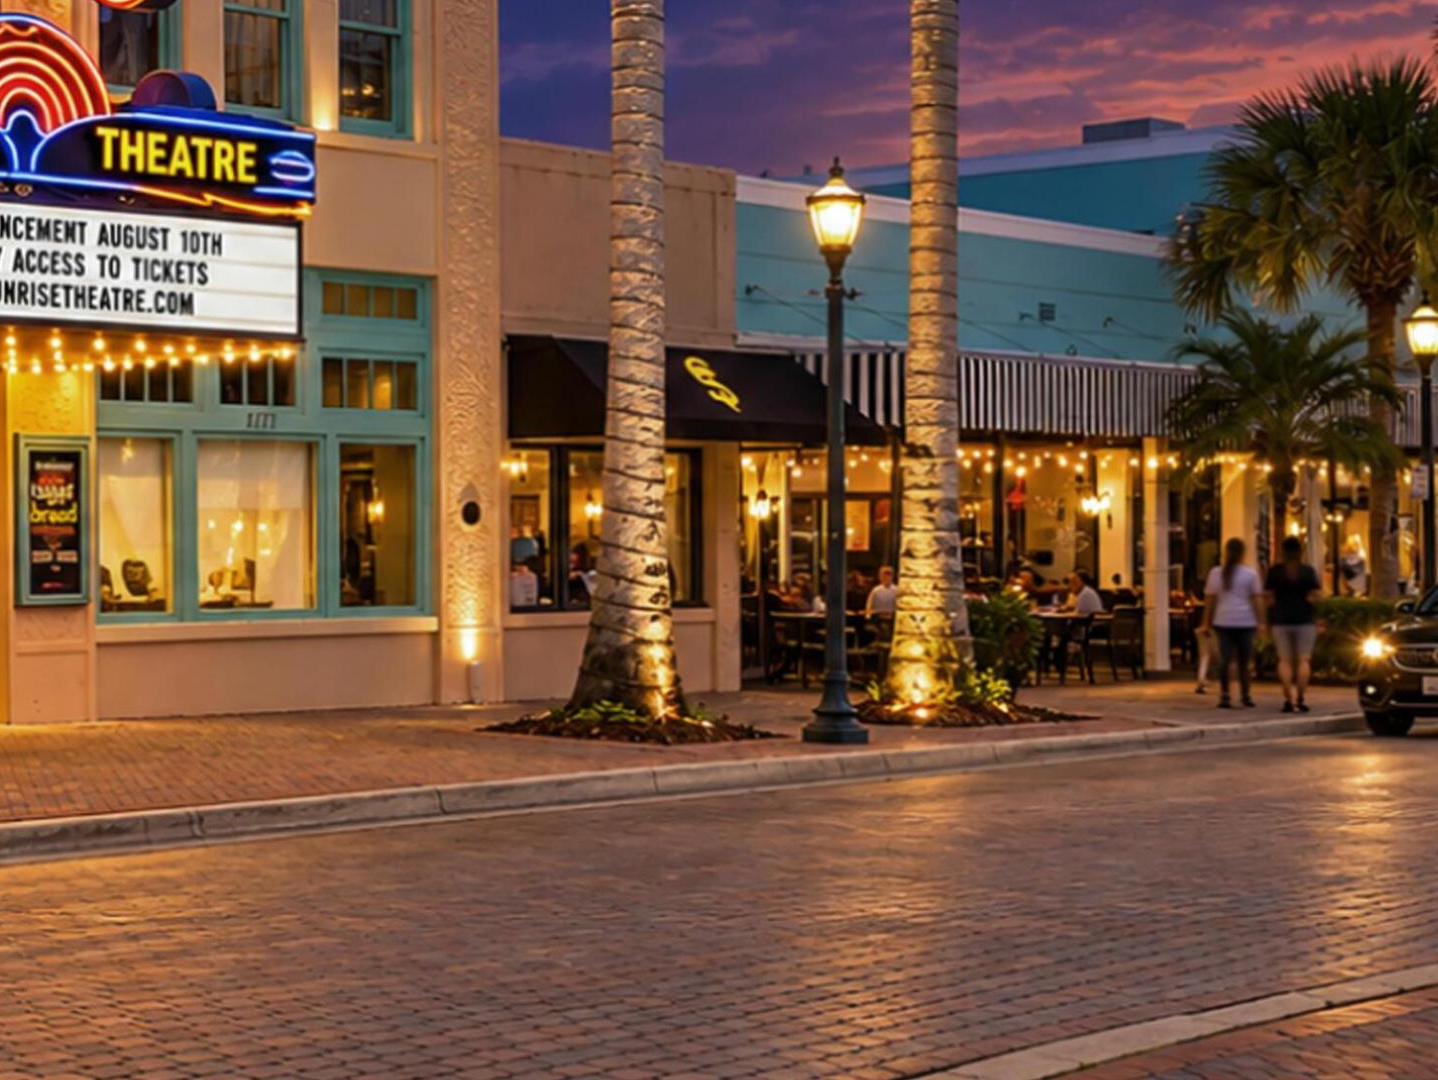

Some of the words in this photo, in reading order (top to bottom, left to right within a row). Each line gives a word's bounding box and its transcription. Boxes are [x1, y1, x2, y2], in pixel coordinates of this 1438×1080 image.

[96, 126, 258, 184] THEATRE
[97, 222, 170, 251] AUGUST
[181, 230, 223, 256] 10TH
[13, 248, 85, 277] ACCESS
[97, 255, 120, 279] TO
[132, 256, 209, 285] TICKETS
